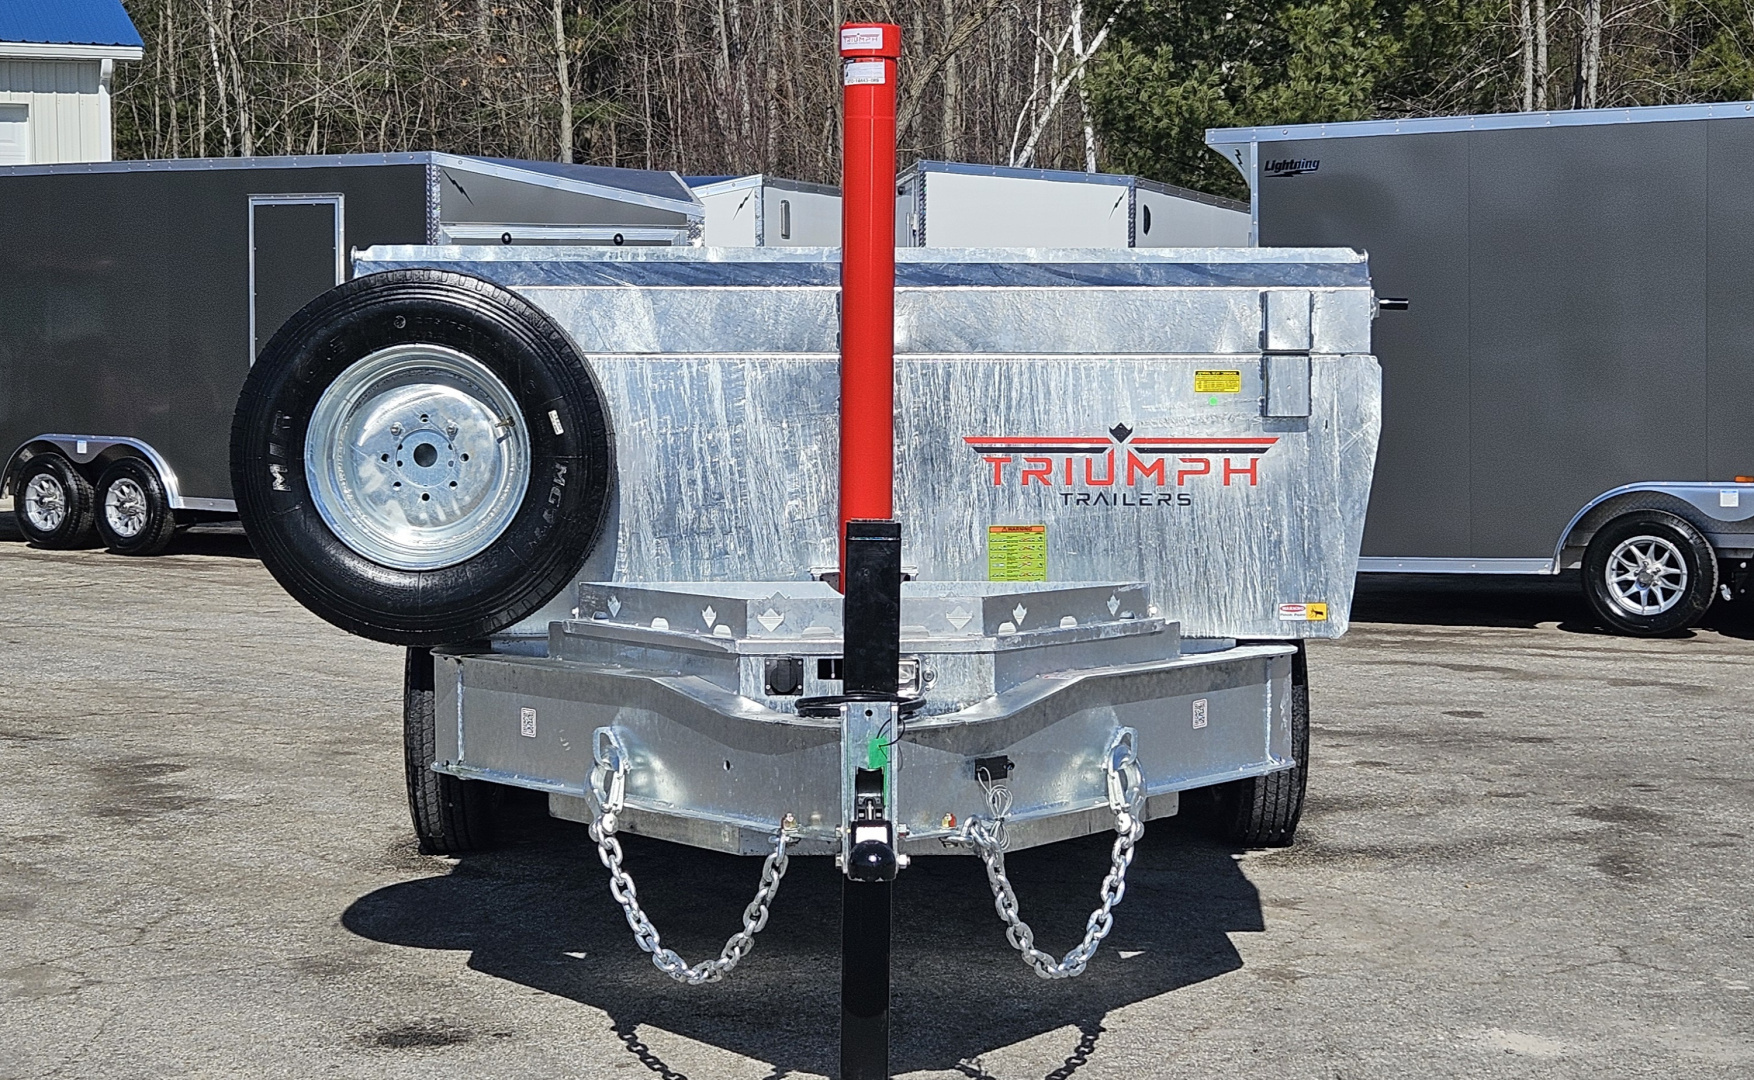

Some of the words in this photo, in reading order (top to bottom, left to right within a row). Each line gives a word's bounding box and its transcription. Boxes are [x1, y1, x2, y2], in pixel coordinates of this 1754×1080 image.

[844, 35, 878, 43] TRIUMPH
[1263, 158, 1320, 173] Lightning
[982, 448, 1261, 487] TRIUMPH
[1059, 492, 1192, 507] TRAILERS
